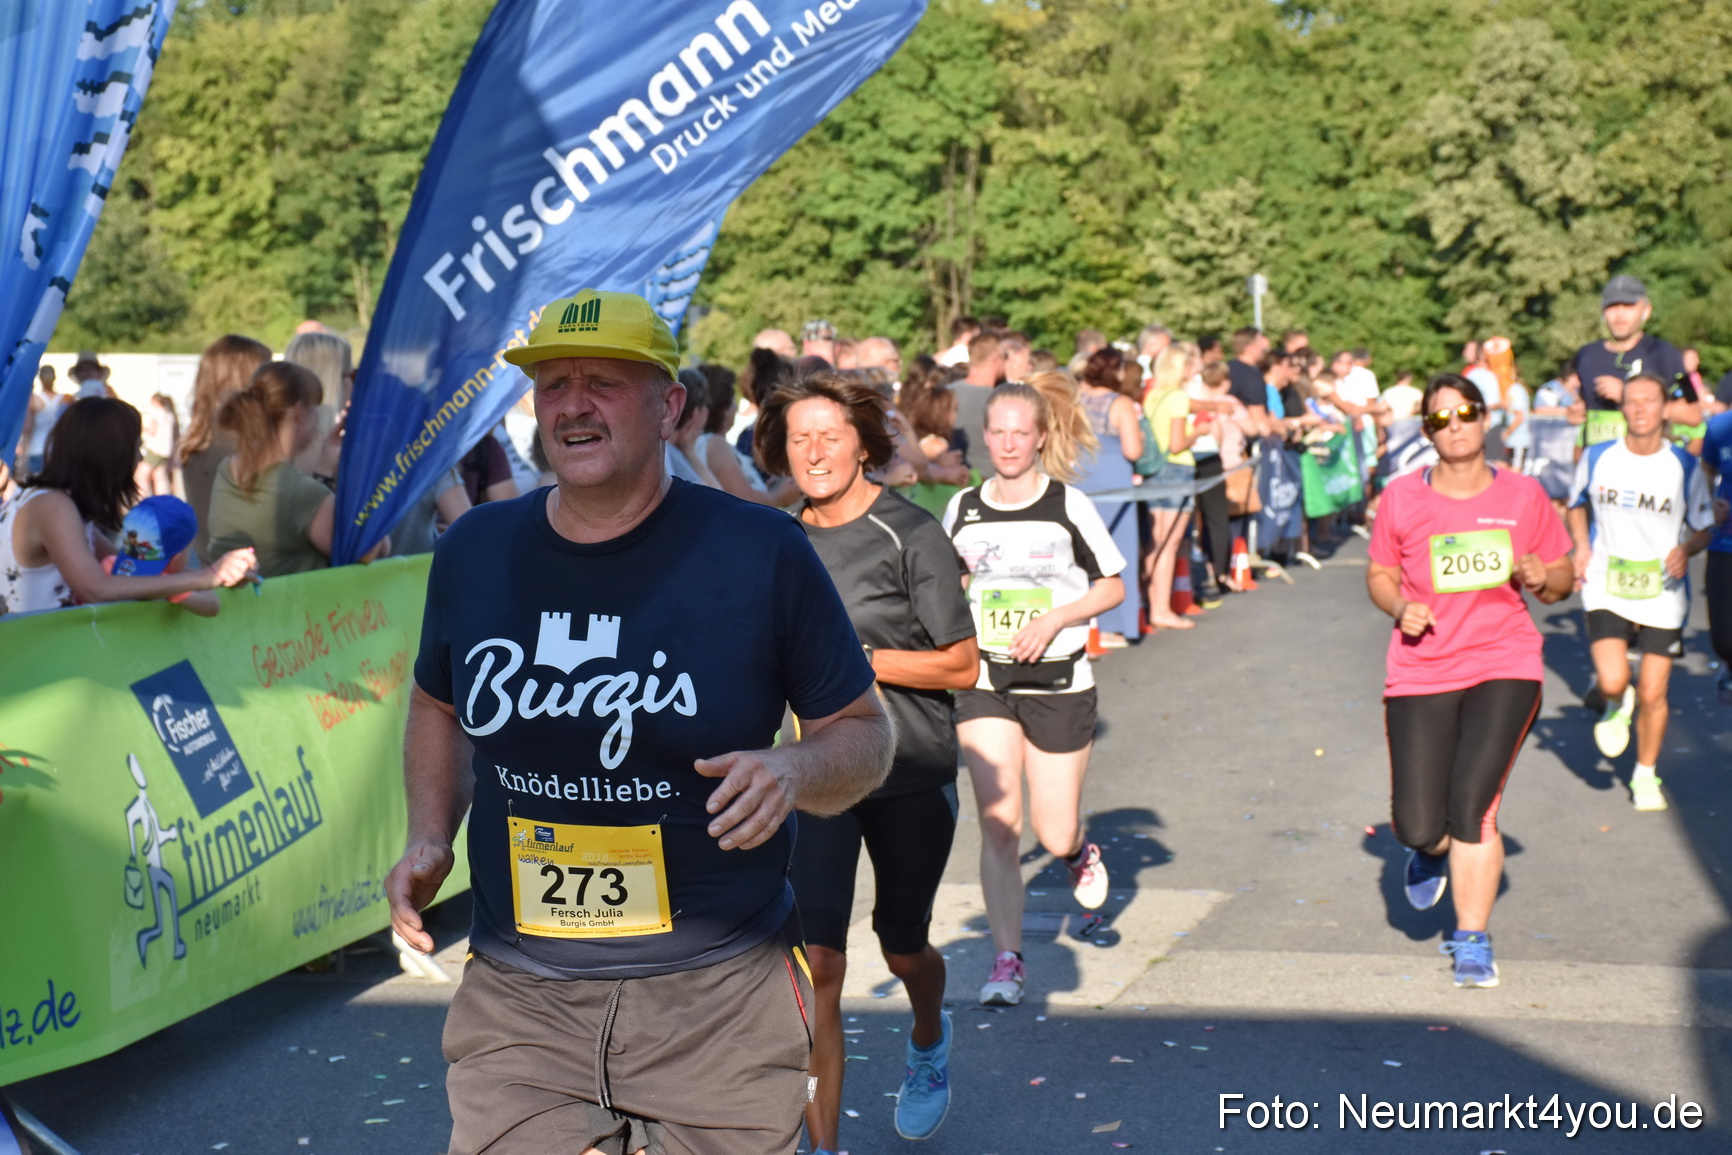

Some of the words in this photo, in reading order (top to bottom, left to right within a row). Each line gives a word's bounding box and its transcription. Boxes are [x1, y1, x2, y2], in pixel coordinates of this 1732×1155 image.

[649, 92, 738, 175] Druck
[735, 36, 795, 98] und
[423, 0, 771, 322] Frischmann
[354, 305, 547, 526] www.frischmann-netd
[1441, 551, 1502, 575] 2063
[1618, 572, 1650, 588] 829
[252, 611, 330, 688] Gesunde
[327, 600, 392, 649] Firmen
[459, 638, 698, 770] Burgis
[165, 707, 212, 745] Fischer
[494, 764, 681, 802] Knödelliebe.
[176, 745, 323, 906] firmenlauf
[518, 853, 555, 866] walken
[526, 838, 575, 853] firmenlauf
[581, 852, 609, 862] 2018
[540, 864, 629, 907] 273
[195, 874, 262, 943] neumarkt
[550, 907, 591, 919] Fersch
[594, 908, 624, 919] Julia
[560, 919, 587, 929] Burgis
[588, 919, 615, 928] GmbH
